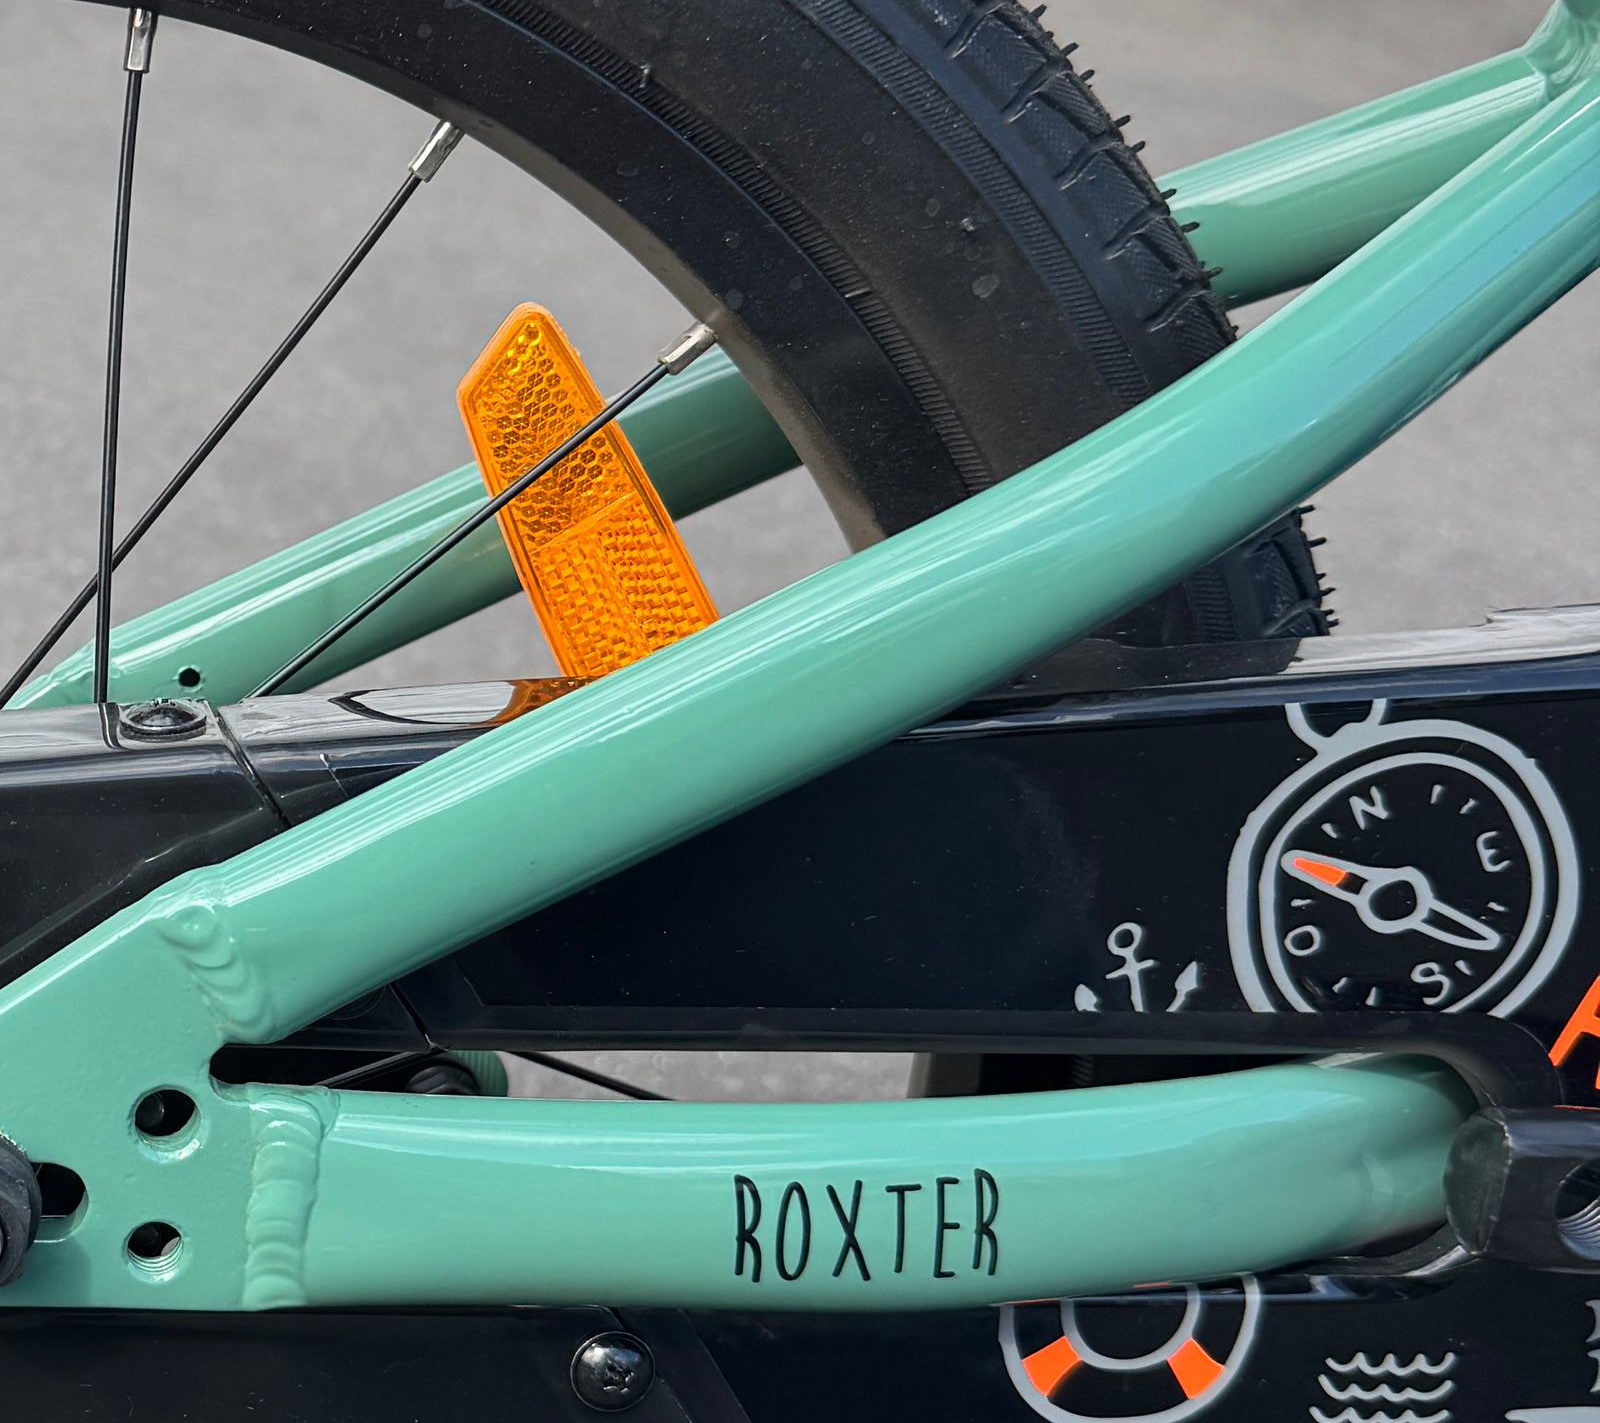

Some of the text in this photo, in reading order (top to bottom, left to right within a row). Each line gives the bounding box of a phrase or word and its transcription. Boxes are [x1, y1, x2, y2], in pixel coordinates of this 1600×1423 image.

[1349, 785, 1389, 830] N
[1475, 830, 1512, 873] E
[1410, 961, 1451, 1006] S
[733, 1168, 999, 1283] ROXTER
